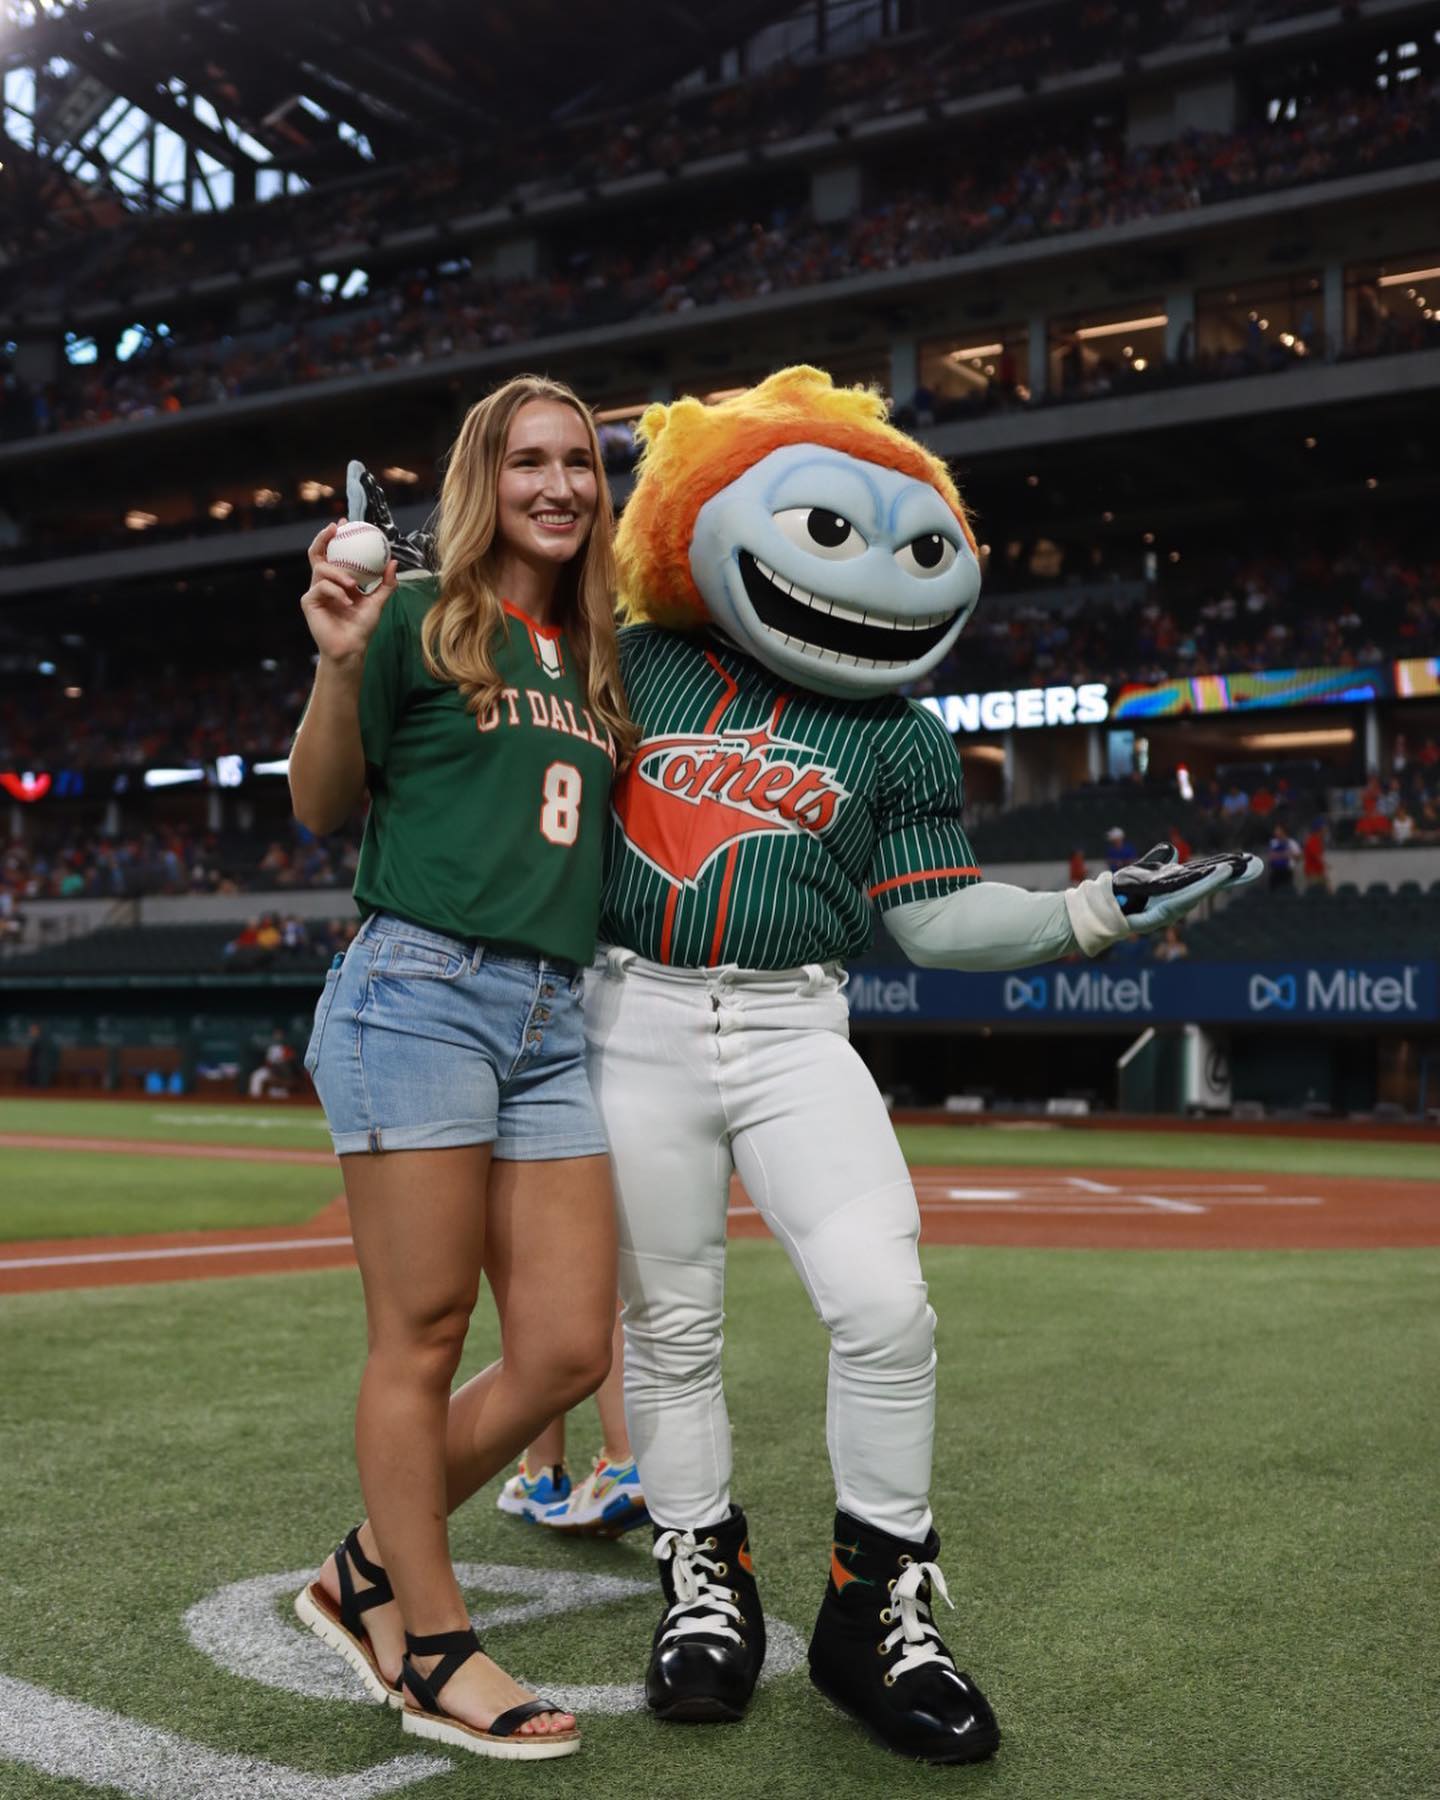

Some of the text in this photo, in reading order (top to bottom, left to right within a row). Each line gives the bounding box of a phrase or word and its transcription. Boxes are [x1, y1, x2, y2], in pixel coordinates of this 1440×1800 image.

[540, 759, 583, 847] 8
[1056, 970, 1153, 1012] Mitel
[1307, 966, 1416, 1012] Mitel
